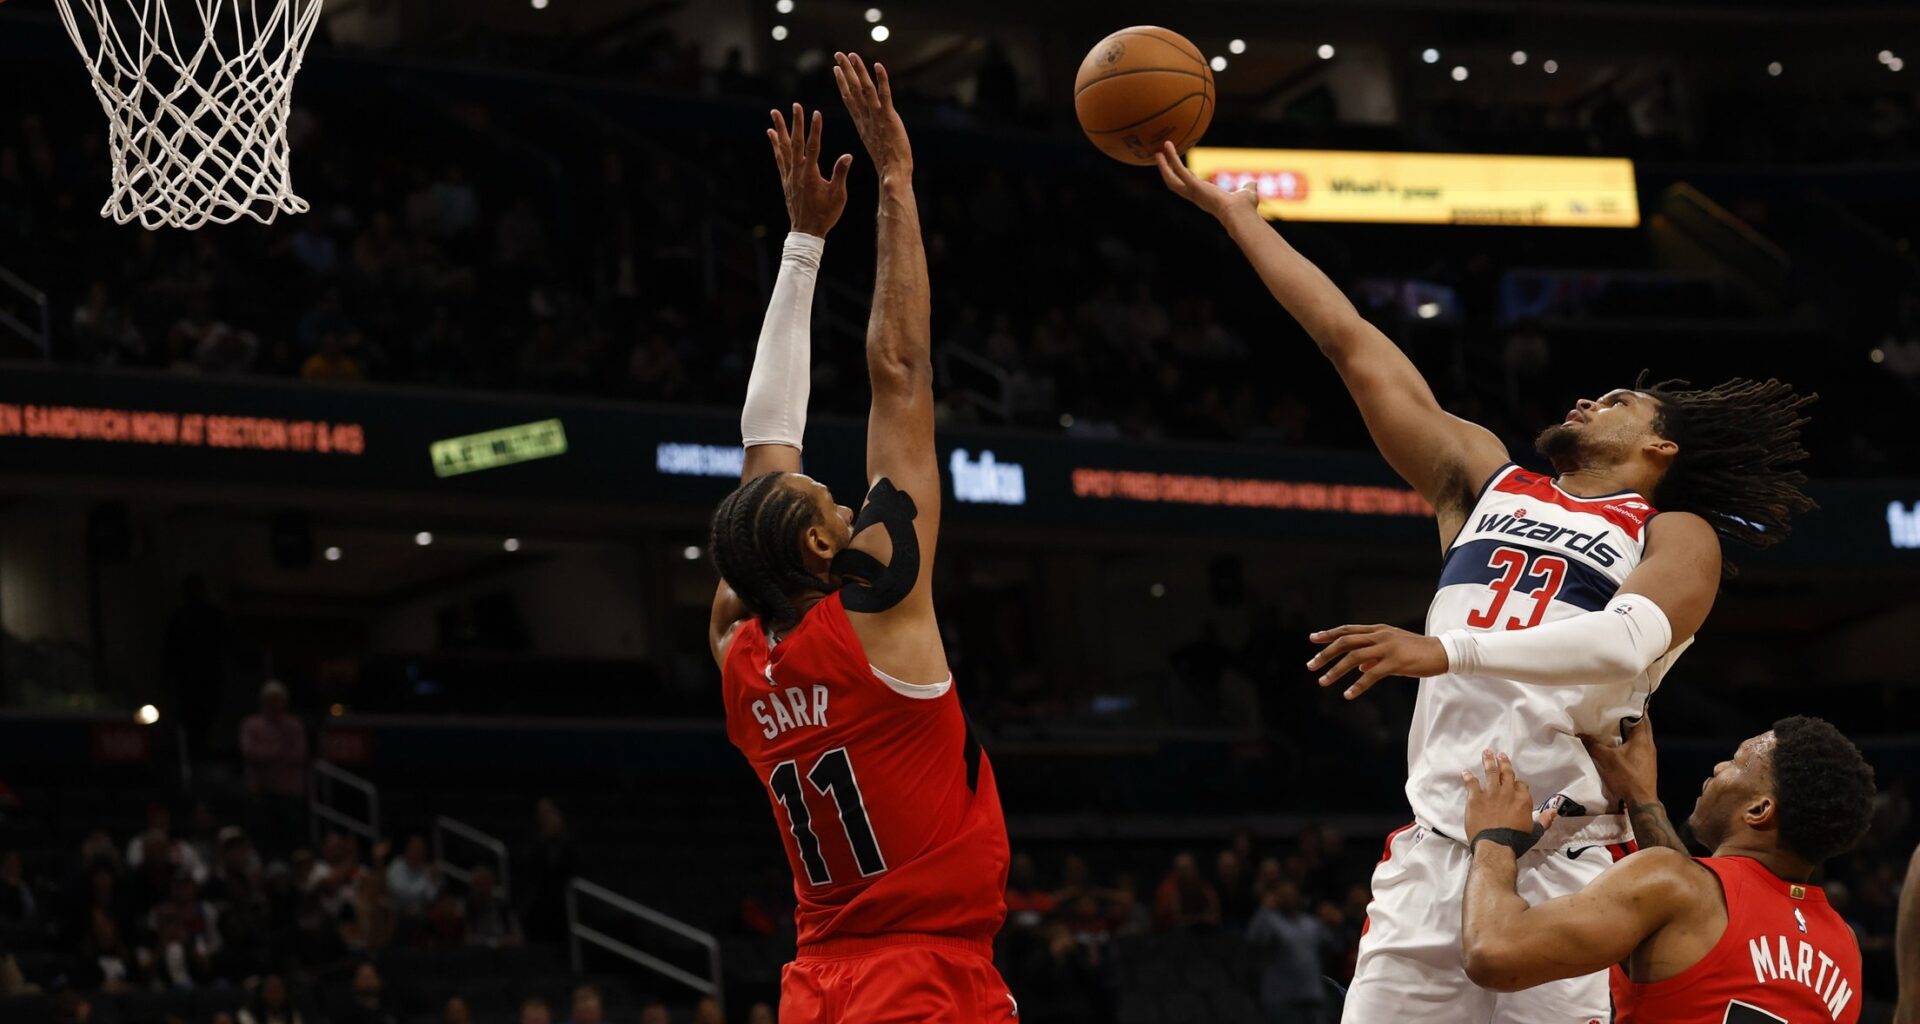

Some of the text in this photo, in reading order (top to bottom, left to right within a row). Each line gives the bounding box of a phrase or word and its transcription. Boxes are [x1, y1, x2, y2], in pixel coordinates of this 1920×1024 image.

[24, 405, 129, 441] SANDWICH
[131, 412, 178, 443] NOW
[180, 415, 204, 445] AT
[206, 416, 287, 450] SECTION
[1475, 509, 1623, 568] wizards
[1467, 547, 1568, 629] 33
[751, 684, 829, 740] SARR
[769, 746, 888, 887] 11
[1749, 935, 1853, 1022] MARTIN
